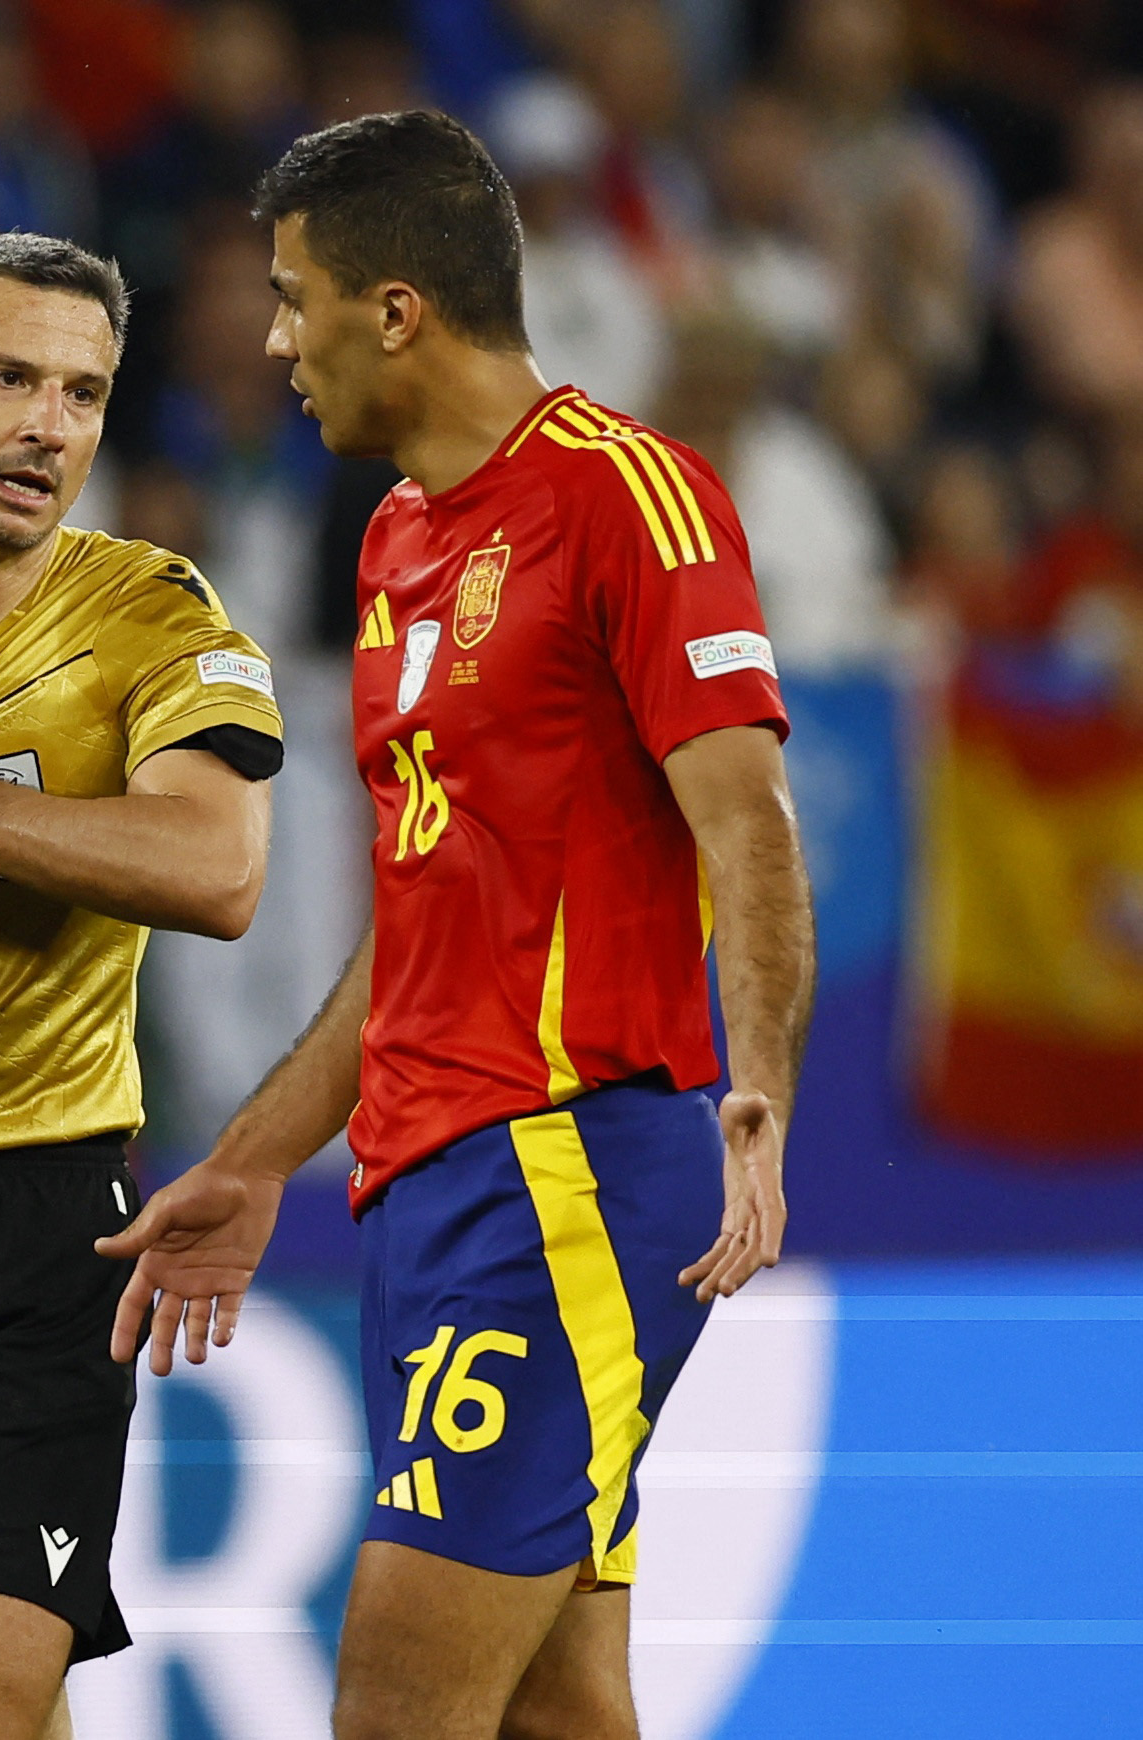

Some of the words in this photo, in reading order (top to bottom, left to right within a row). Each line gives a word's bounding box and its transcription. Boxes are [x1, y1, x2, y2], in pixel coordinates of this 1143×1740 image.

[201, 652, 227, 663] UEFA
[690, 640, 715, 652] UEFA
[387, 730, 449, 861] 16
[398, 1325, 527, 1453] 16
